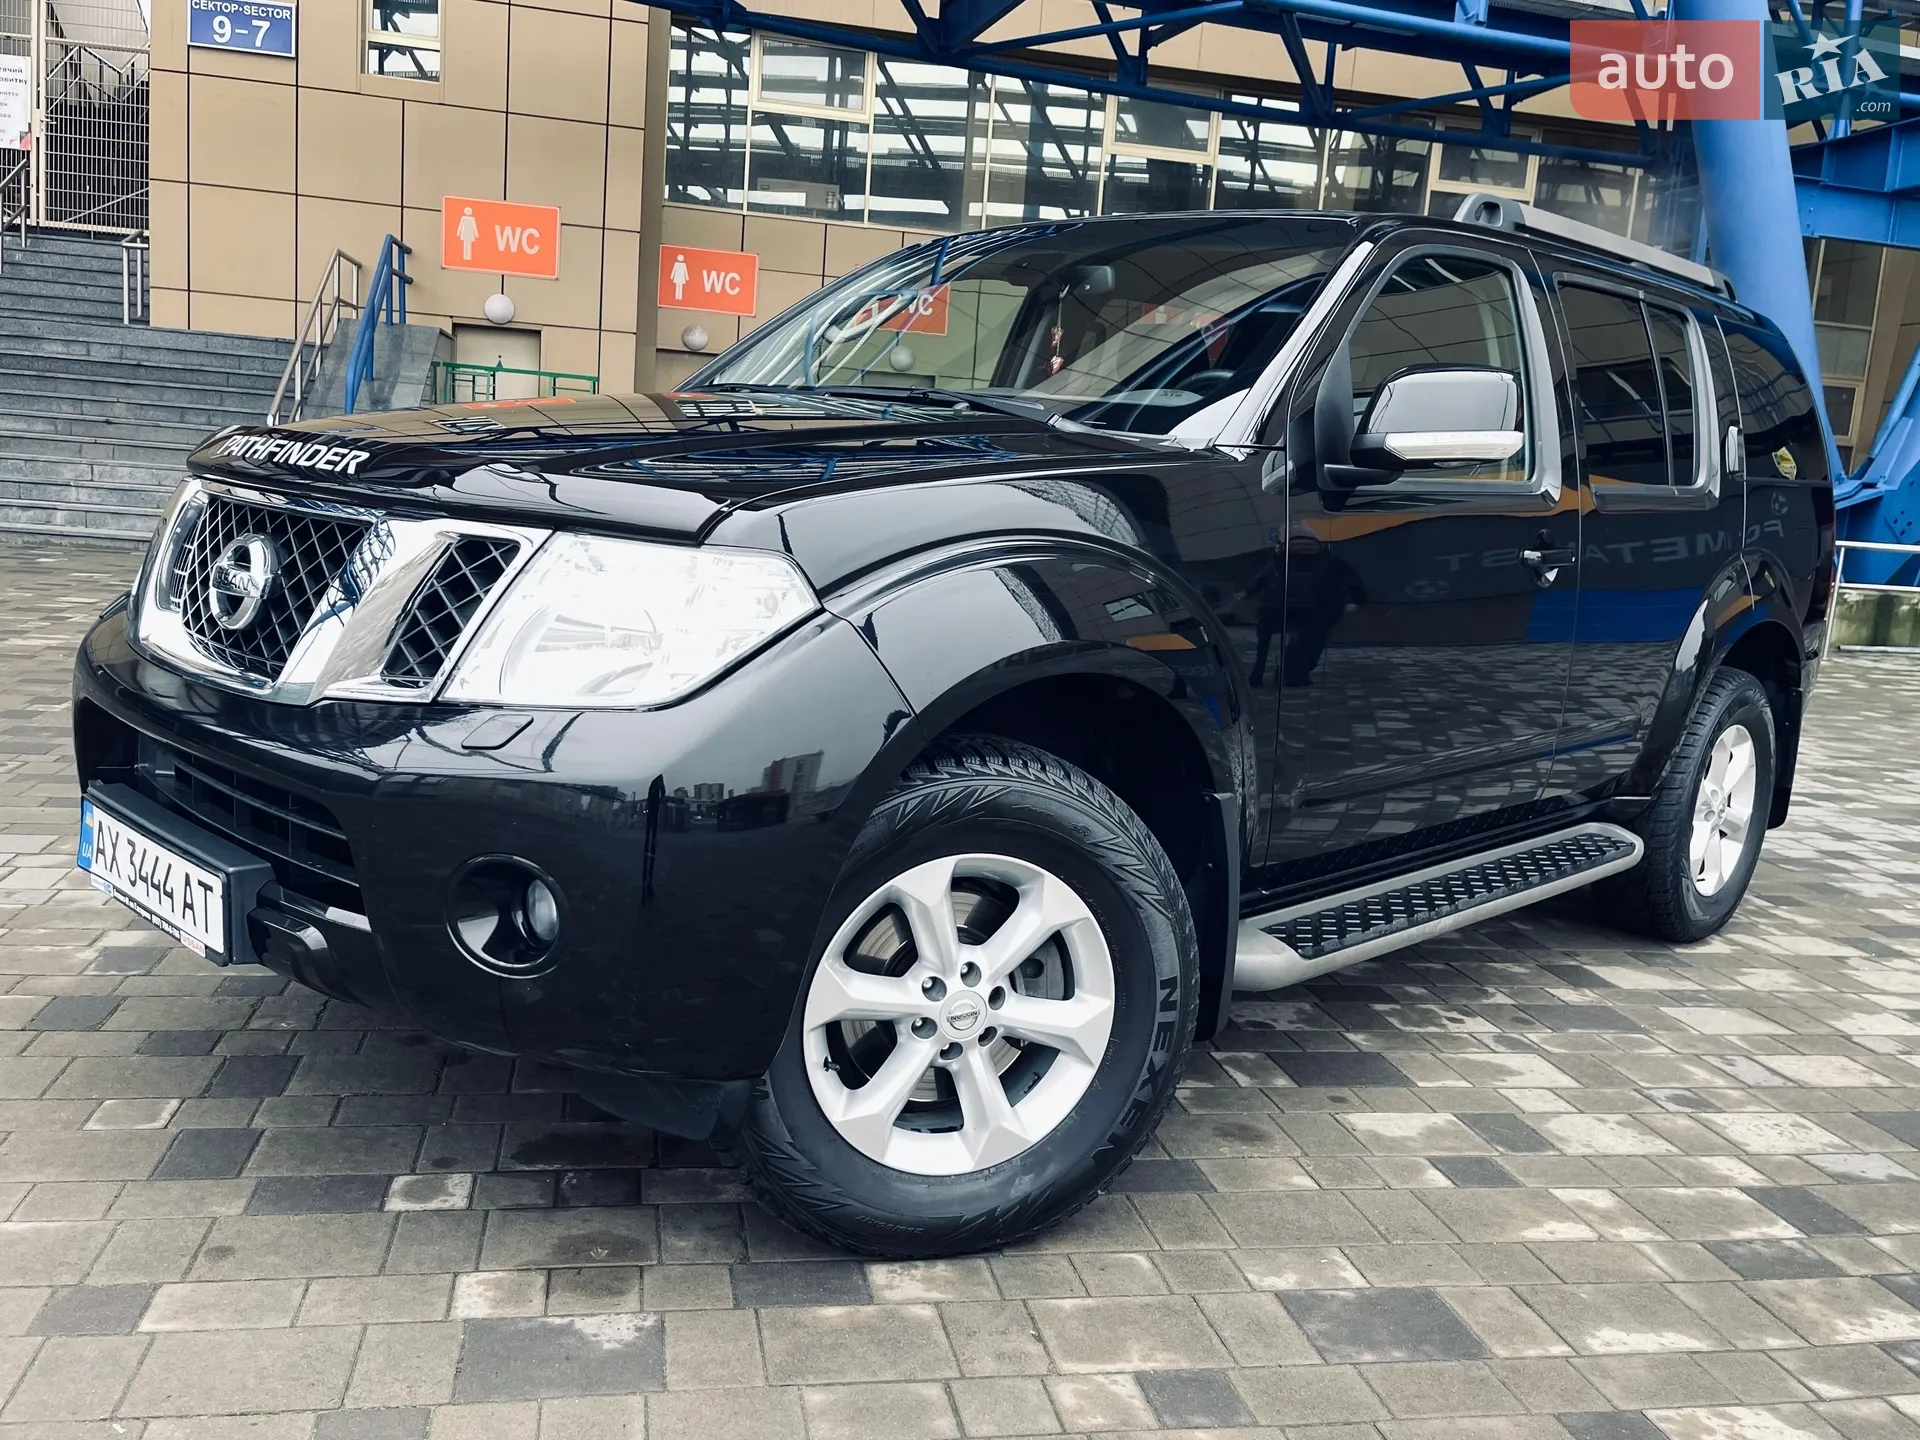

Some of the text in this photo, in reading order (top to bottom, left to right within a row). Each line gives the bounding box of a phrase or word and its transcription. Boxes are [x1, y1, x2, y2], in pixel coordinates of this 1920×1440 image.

[494, 224, 541, 255] WC
[702, 269, 741, 296] WC
[216, 435, 371, 475] PATHFINDER
[82, 842, 92, 860] UA
[95, 819, 122, 879] AX
[127, 836, 175, 914] 3444
[182, 871, 214, 934] AT
[1091, 975, 1178, 1167] NEXEN
